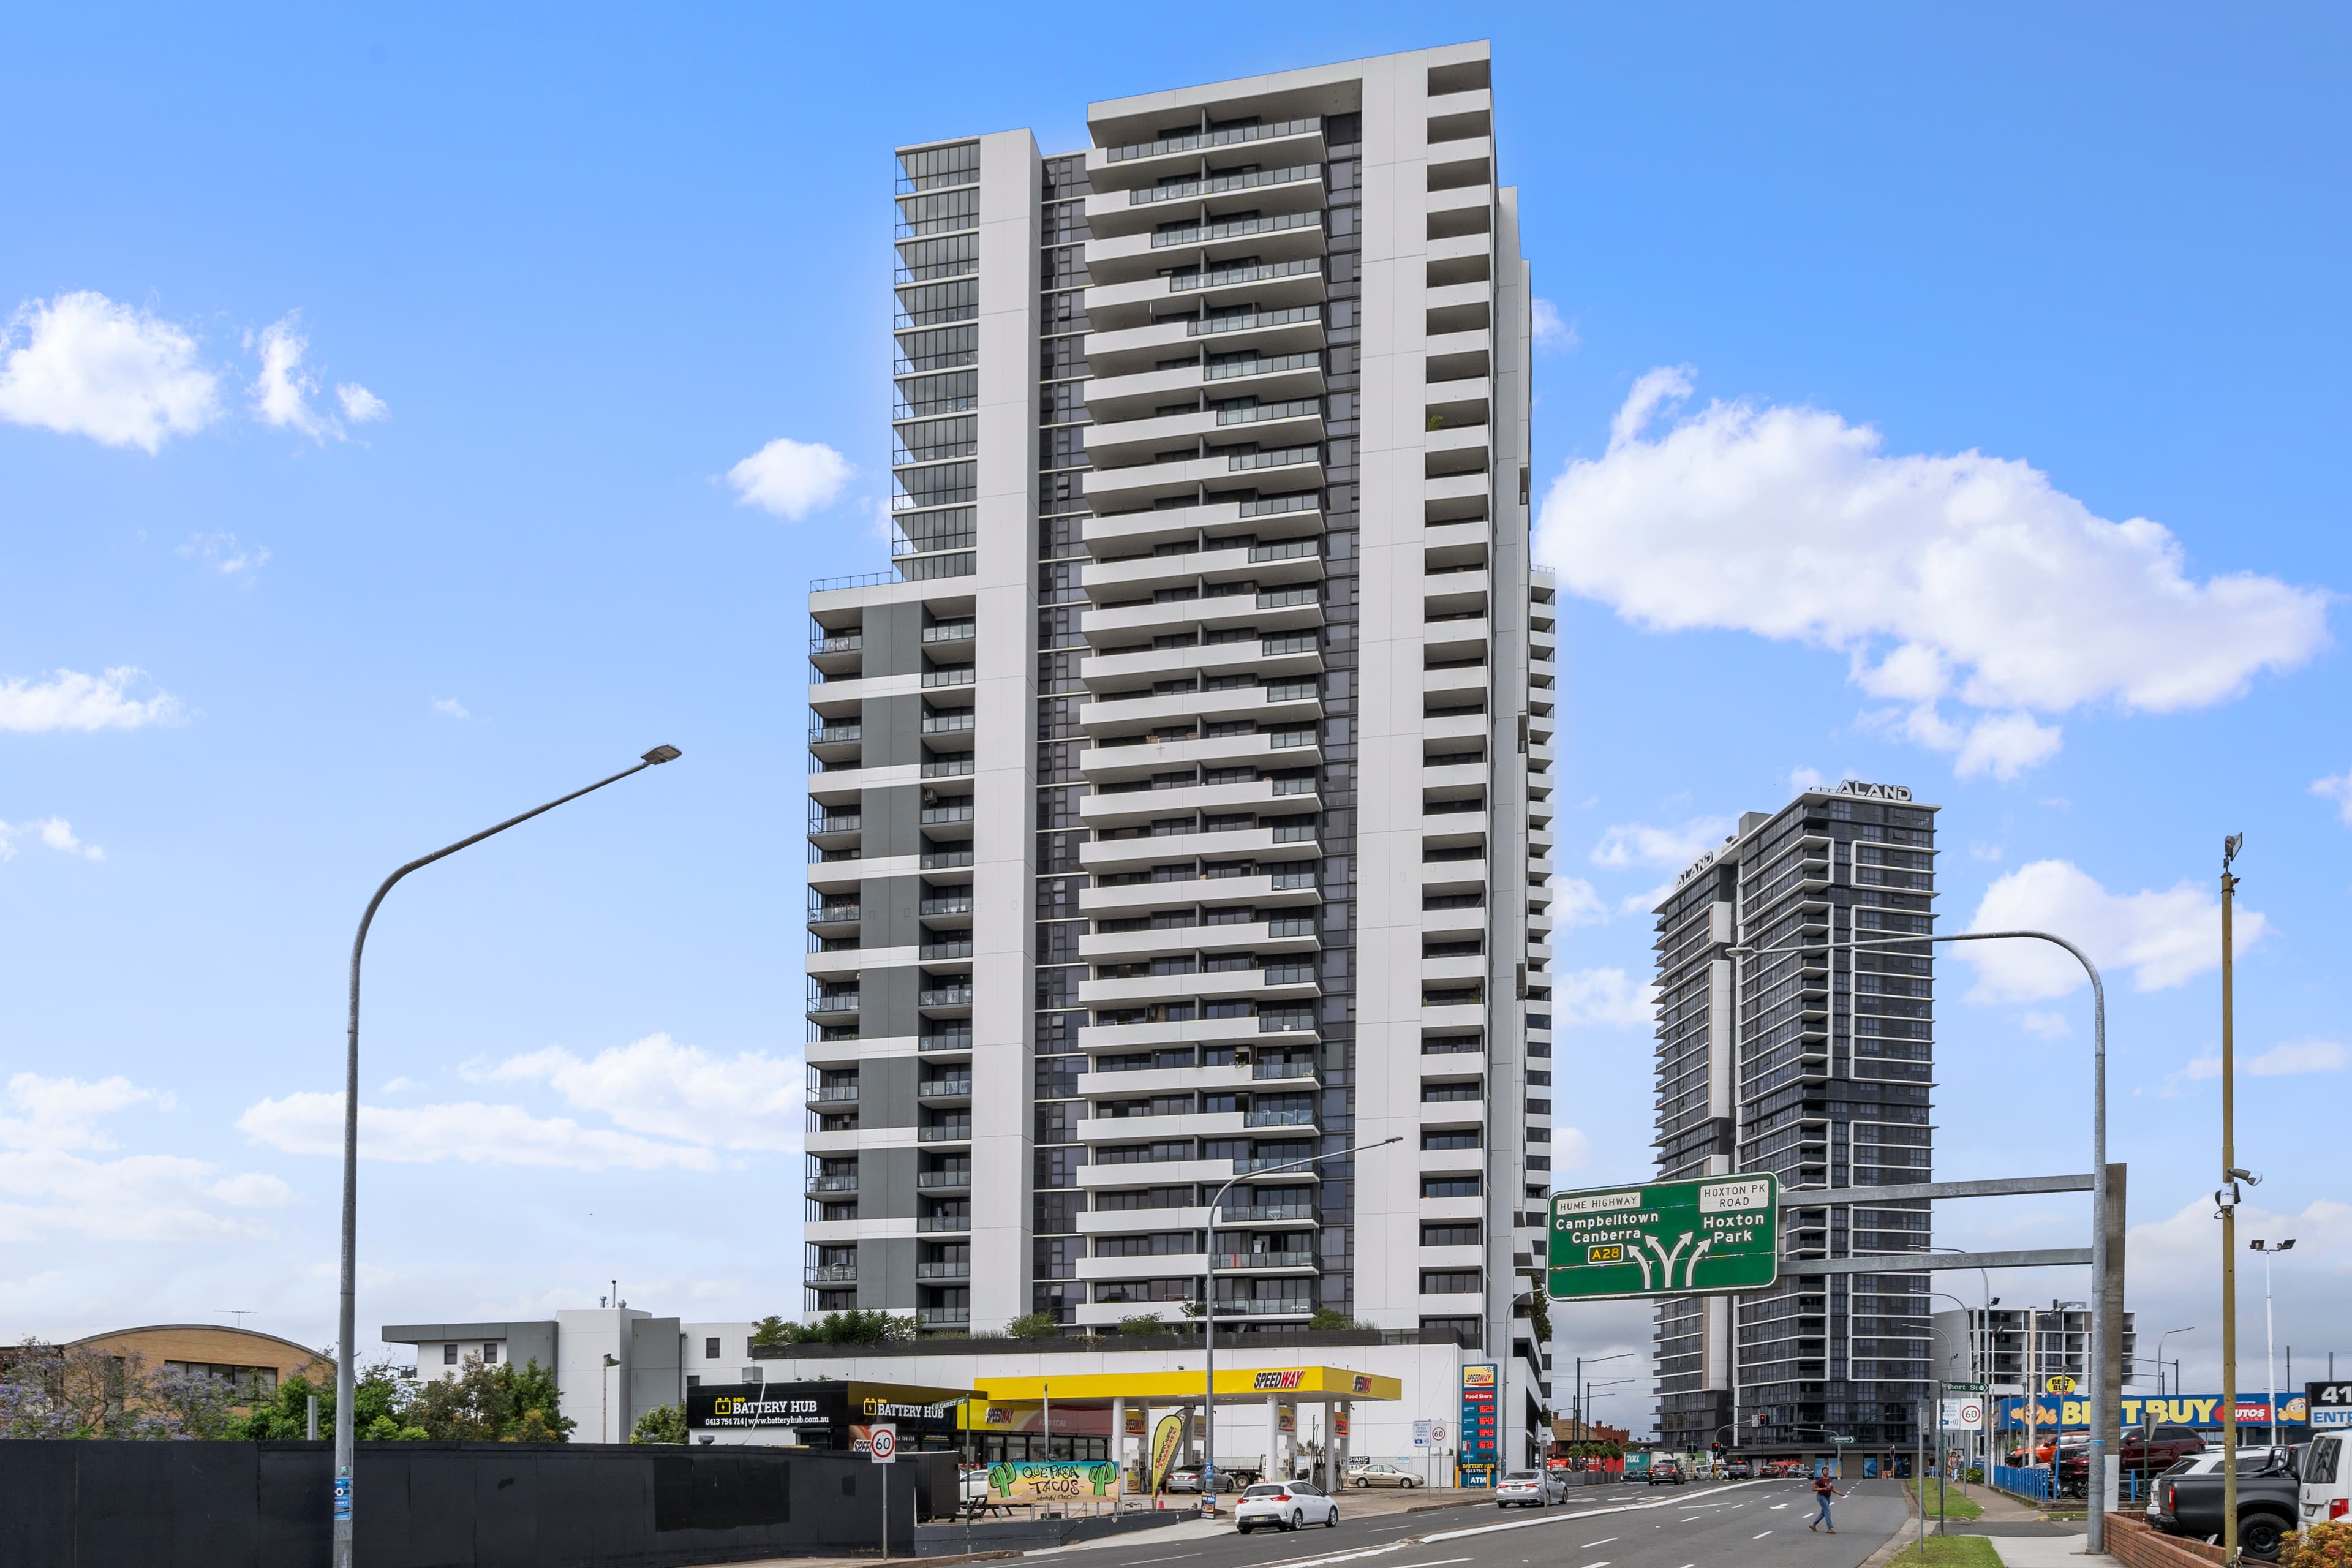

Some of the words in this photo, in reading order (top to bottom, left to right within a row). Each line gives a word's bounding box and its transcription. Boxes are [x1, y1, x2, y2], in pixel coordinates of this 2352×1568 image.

[1837, 779, 1912, 801] ALAND
[1675, 851, 1714, 891] ALAND
[1704, 1186, 1746, 1198] HOXTON
[1751, 1183, 1766, 1194] PK
[1559, 1200, 1587, 1212] HUME
[1592, 1196, 1637, 1208] HIGHWAY
[1719, 1197, 1750, 1208] ROAD
[1556, 1212, 1659, 1231] Campbelltown
[1703, 1213, 1765, 1229] Hoxton
[1572, 1229, 1642, 1244] Canberra
[1714, 1229, 1753, 1244] Park
[1592, 1248, 1620, 1260] A28
[1254, 1370, 1305, 1389] SPEEDWAY
[1466, 1374, 1493, 1382] SPEEDWAY
[733, 1401, 788, 1414] BATTERY
[790, 1401, 817, 1412] HUB
[878, 1403, 922, 1417] BATTERY
[924, 1406, 944, 1419] HUB
[986, 1407, 1014, 1423] SPEEDWAY
[2062, 1400, 2142, 1424] BT
[2146, 1398, 2218, 1424] BUY
[2234, 1409, 2265, 1417] UTOS
[748, 1416, 829, 1426] www.batteryhub.com.au
[852, 1439, 872, 1452] SPEE
[876, 1437, 891, 1450] 60
[1023, 1464, 1048, 1479] QUE
